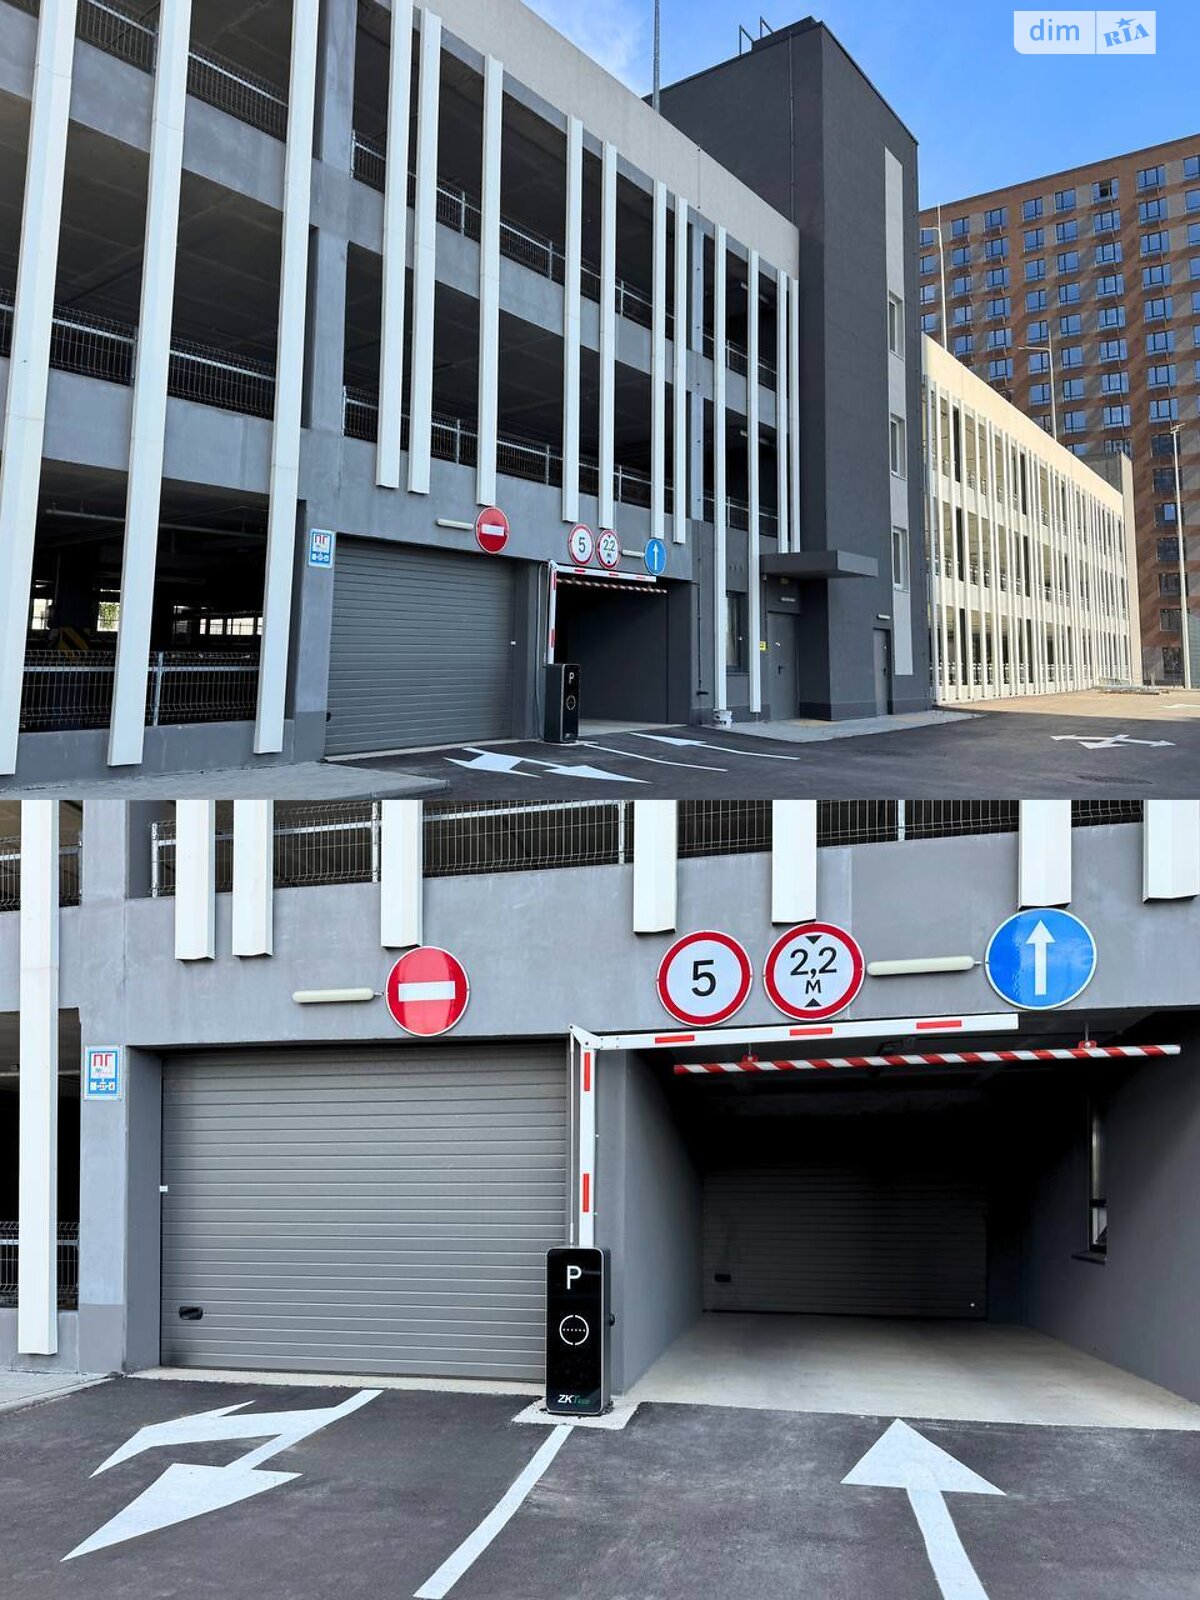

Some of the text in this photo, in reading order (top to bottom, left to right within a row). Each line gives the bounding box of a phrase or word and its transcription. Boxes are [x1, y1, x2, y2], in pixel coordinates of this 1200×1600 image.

[578, 536, 586, 553] 5
[568, 672, 575, 684] P
[790, 946, 837, 979] 2,2
[691, 959, 715, 997] 5
[566, 1265, 582, 1290] P
[558, 1394, 590, 1404] ZKT
